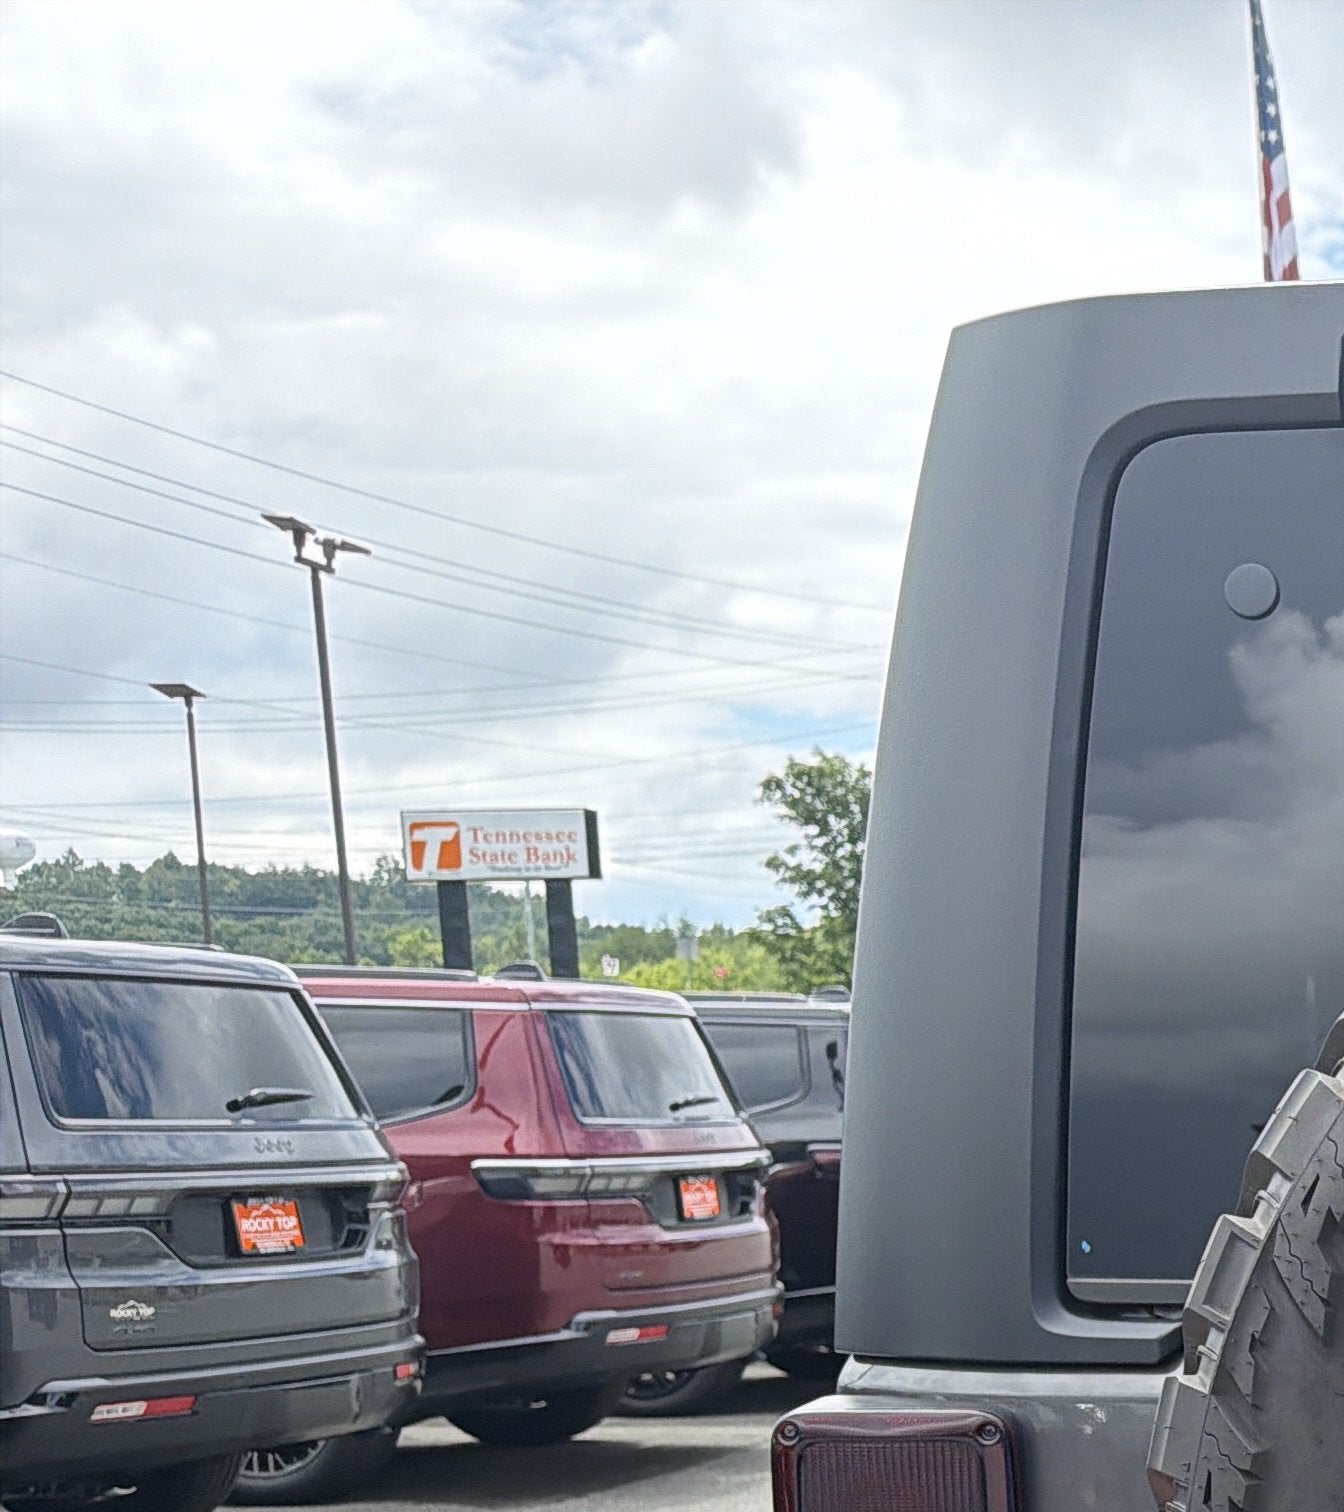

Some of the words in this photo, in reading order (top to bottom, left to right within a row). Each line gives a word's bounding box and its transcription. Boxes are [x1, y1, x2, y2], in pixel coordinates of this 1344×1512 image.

[466, 826, 578, 844] Tennessee
[468, 847, 519, 864] State
[525, 846, 578, 864] Bank
[241, 1217, 274, 1232] ROCKY
